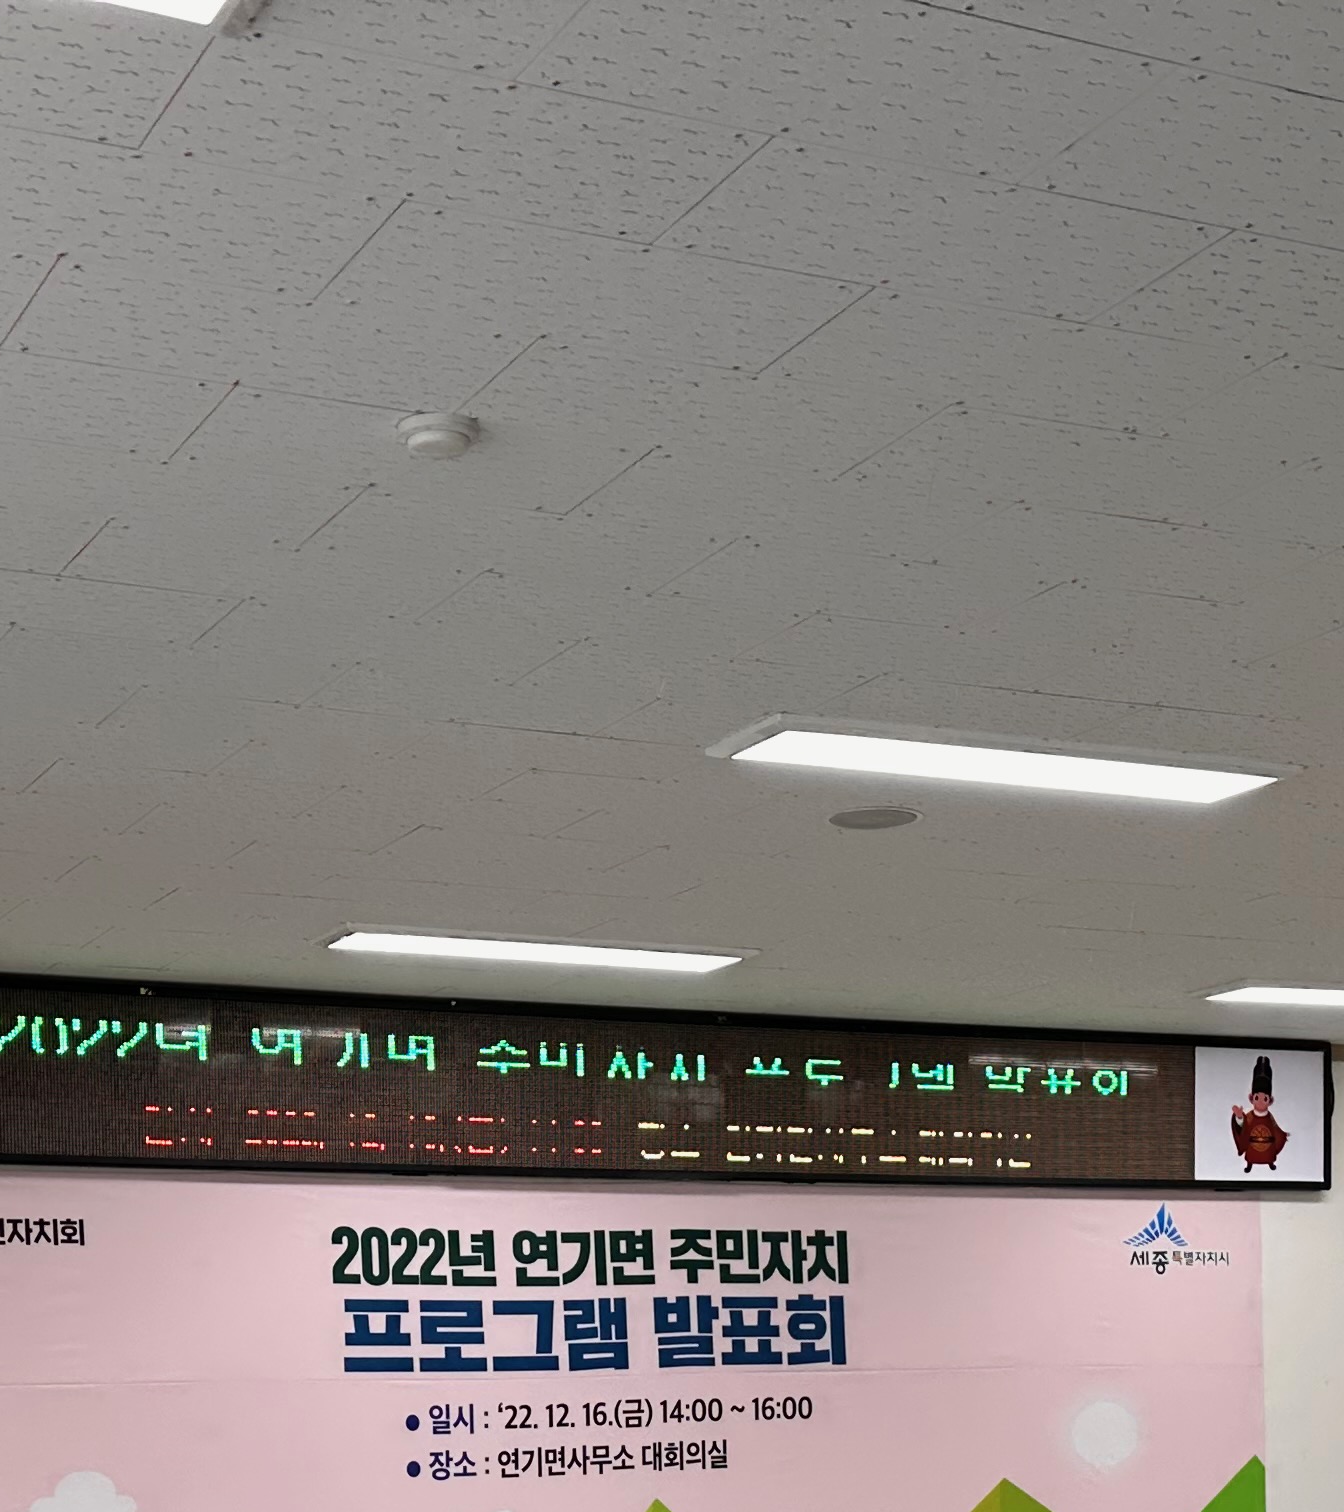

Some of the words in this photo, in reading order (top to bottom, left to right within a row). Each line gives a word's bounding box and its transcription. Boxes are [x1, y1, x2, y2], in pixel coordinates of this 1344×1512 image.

[332, 1226, 497, 1286] 2022년
[513, 1229, 655, 1286] 연기면
[670, 1229, 849, 1284] 주민자치
[344, 1297, 629, 1372] 프로그램
[653, 1294, 846, 1368] 발표회
[429, 1404, 474, 1434] 일시
[660, 1398, 722, 1423] 14:00
[752, 1397, 812, 1420] 16:00
[429, 1450, 477, 1480] 장소
[498, 1445, 635, 1478] 연기면사무소
[642, 1439, 727, 1471] 대회의실
